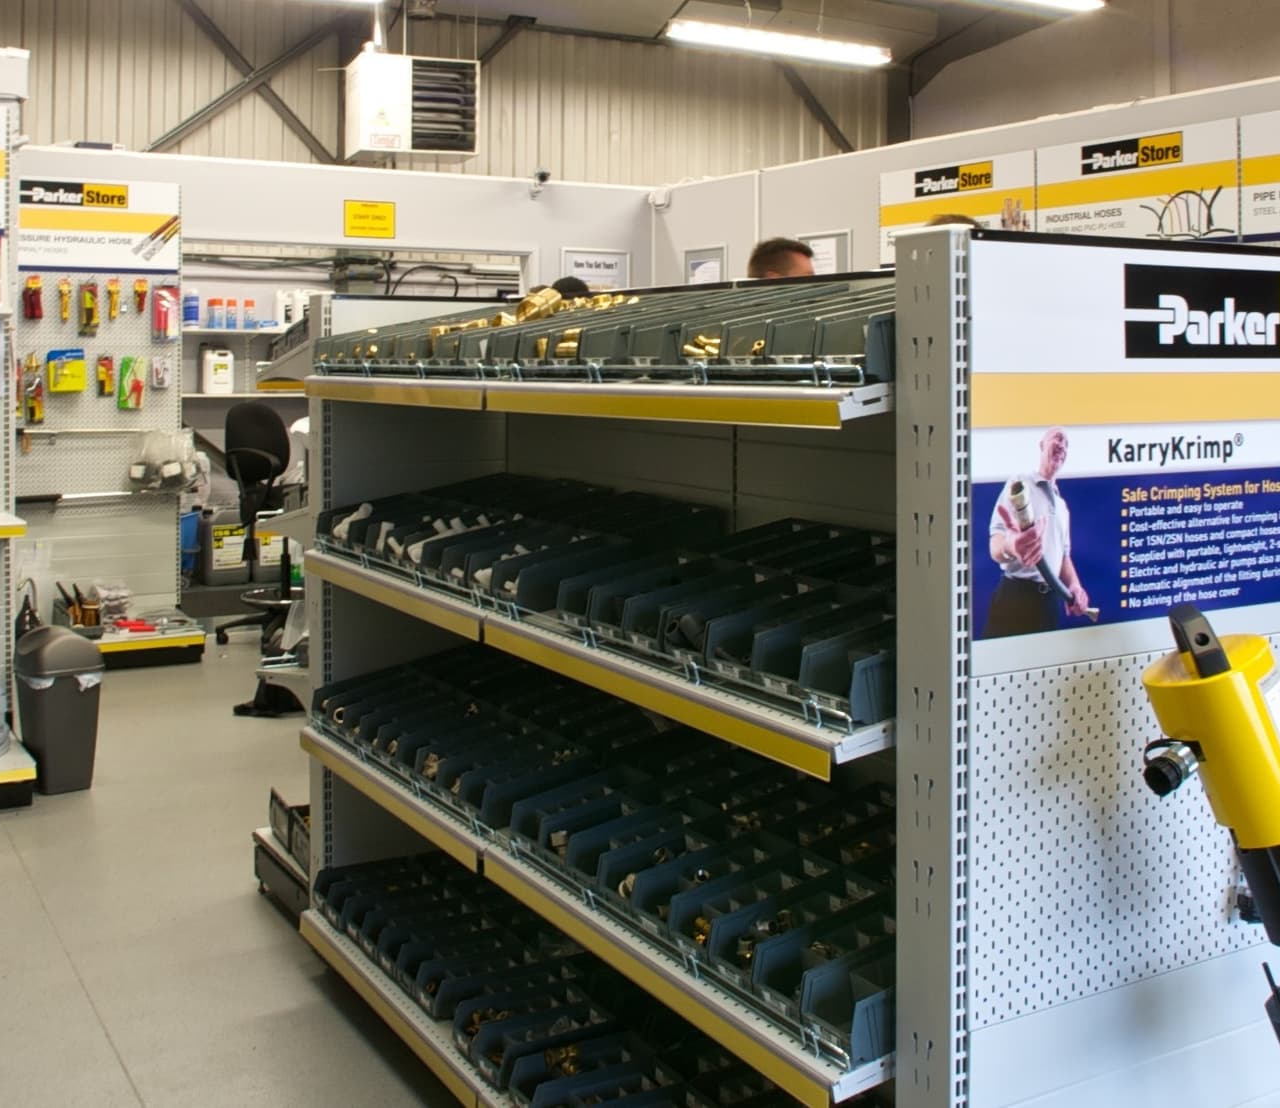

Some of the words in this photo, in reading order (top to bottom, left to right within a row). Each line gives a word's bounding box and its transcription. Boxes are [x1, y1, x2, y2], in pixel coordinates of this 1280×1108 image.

[1140, 145, 1180, 163] Store
[960, 169, 992, 188] Store
[85, 190, 126, 205] Store
[1253, 190, 1276, 202] PIPE
[1045, 211, 1091, 223] INDUSTRIAL
[1094, 208, 1122, 218] HOSES
[1253, 206, 1277, 216] STEEL
[54, 235, 106, 245] HYDRAULIC
[108, 237, 132, 245] HOSE
[1158, 293, 1280, 346] Parker
[1122, 487, 1148, 502] Safe
[1150, 485, 1200, 502] Crimping
[1203, 482, 1243, 500] System
[1244, 480, 1260, 494] for
[1129, 505, 1165, 517] Portable
[1167, 503, 1182, 514] and
[1184, 504, 1202, 514] easy
[1204, 502, 1212, 511] to
[1214, 500, 1244, 512] operate
[1129, 519, 1187, 532] Cost-effective
[1188, 515, 1230, 528] alternative
[1232, 513, 1243, 524] for
[1244, 510, 1278, 524] crimping
[1129, 536, 1144, 548] For
[1184, 532, 1208, 542] hoses
[1210, 529, 1225, 540] and
[1226, 527, 1258, 540] compact
[1259, 526, 1280, 536] hoses
[1129, 549, 1166, 564] Supplied
[1167, 548, 1185, 559] with
[1129, 564, 1161, 578] Electric
[1163, 563, 1178, 575] and
[1180, 559, 1216, 574] hydraulic
[1218, 558, 1229, 569] air
[1230, 557, 1256, 569] pumps
[1258, 553, 1274, 564] also
[1129, 579, 1171, 593] Automatic
[1172, 575, 1213, 590] alignment
[1214, 572, 1223, 584] of
[1224, 571, 1237, 583] the
[1238, 569, 1261, 581] fitting
[1129, 596, 1141, 608] No
[1173, 591, 1182, 603] of
[1183, 590, 1197, 602] the
[1198, 589, 1218, 600] hose
[1219, 587, 1240, 598] cover
